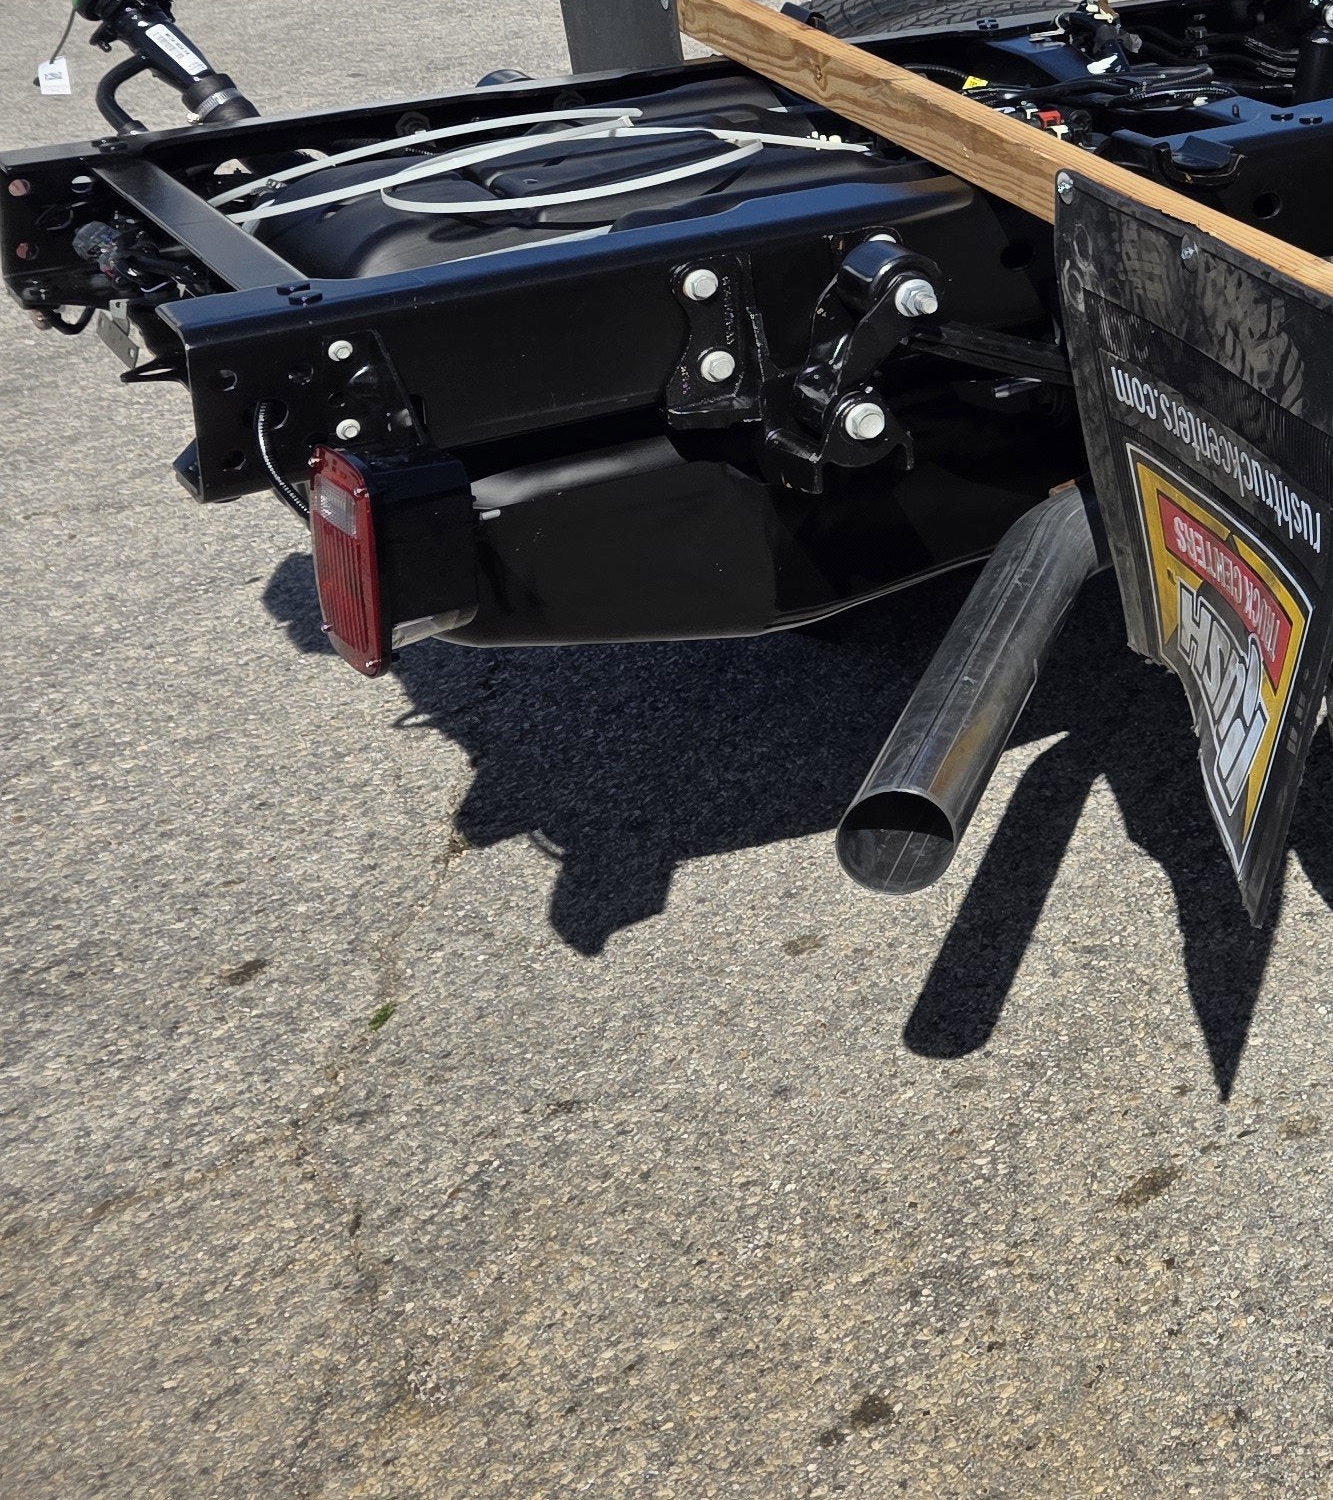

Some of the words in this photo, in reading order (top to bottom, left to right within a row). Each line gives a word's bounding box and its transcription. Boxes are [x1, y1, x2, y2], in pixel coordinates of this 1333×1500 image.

[1110, 365, 1321, 553] rushtruckcenters.com
[1174, 515, 1243, 603] CENTERS
[1242, 576, 1279, 663] TRUCK
